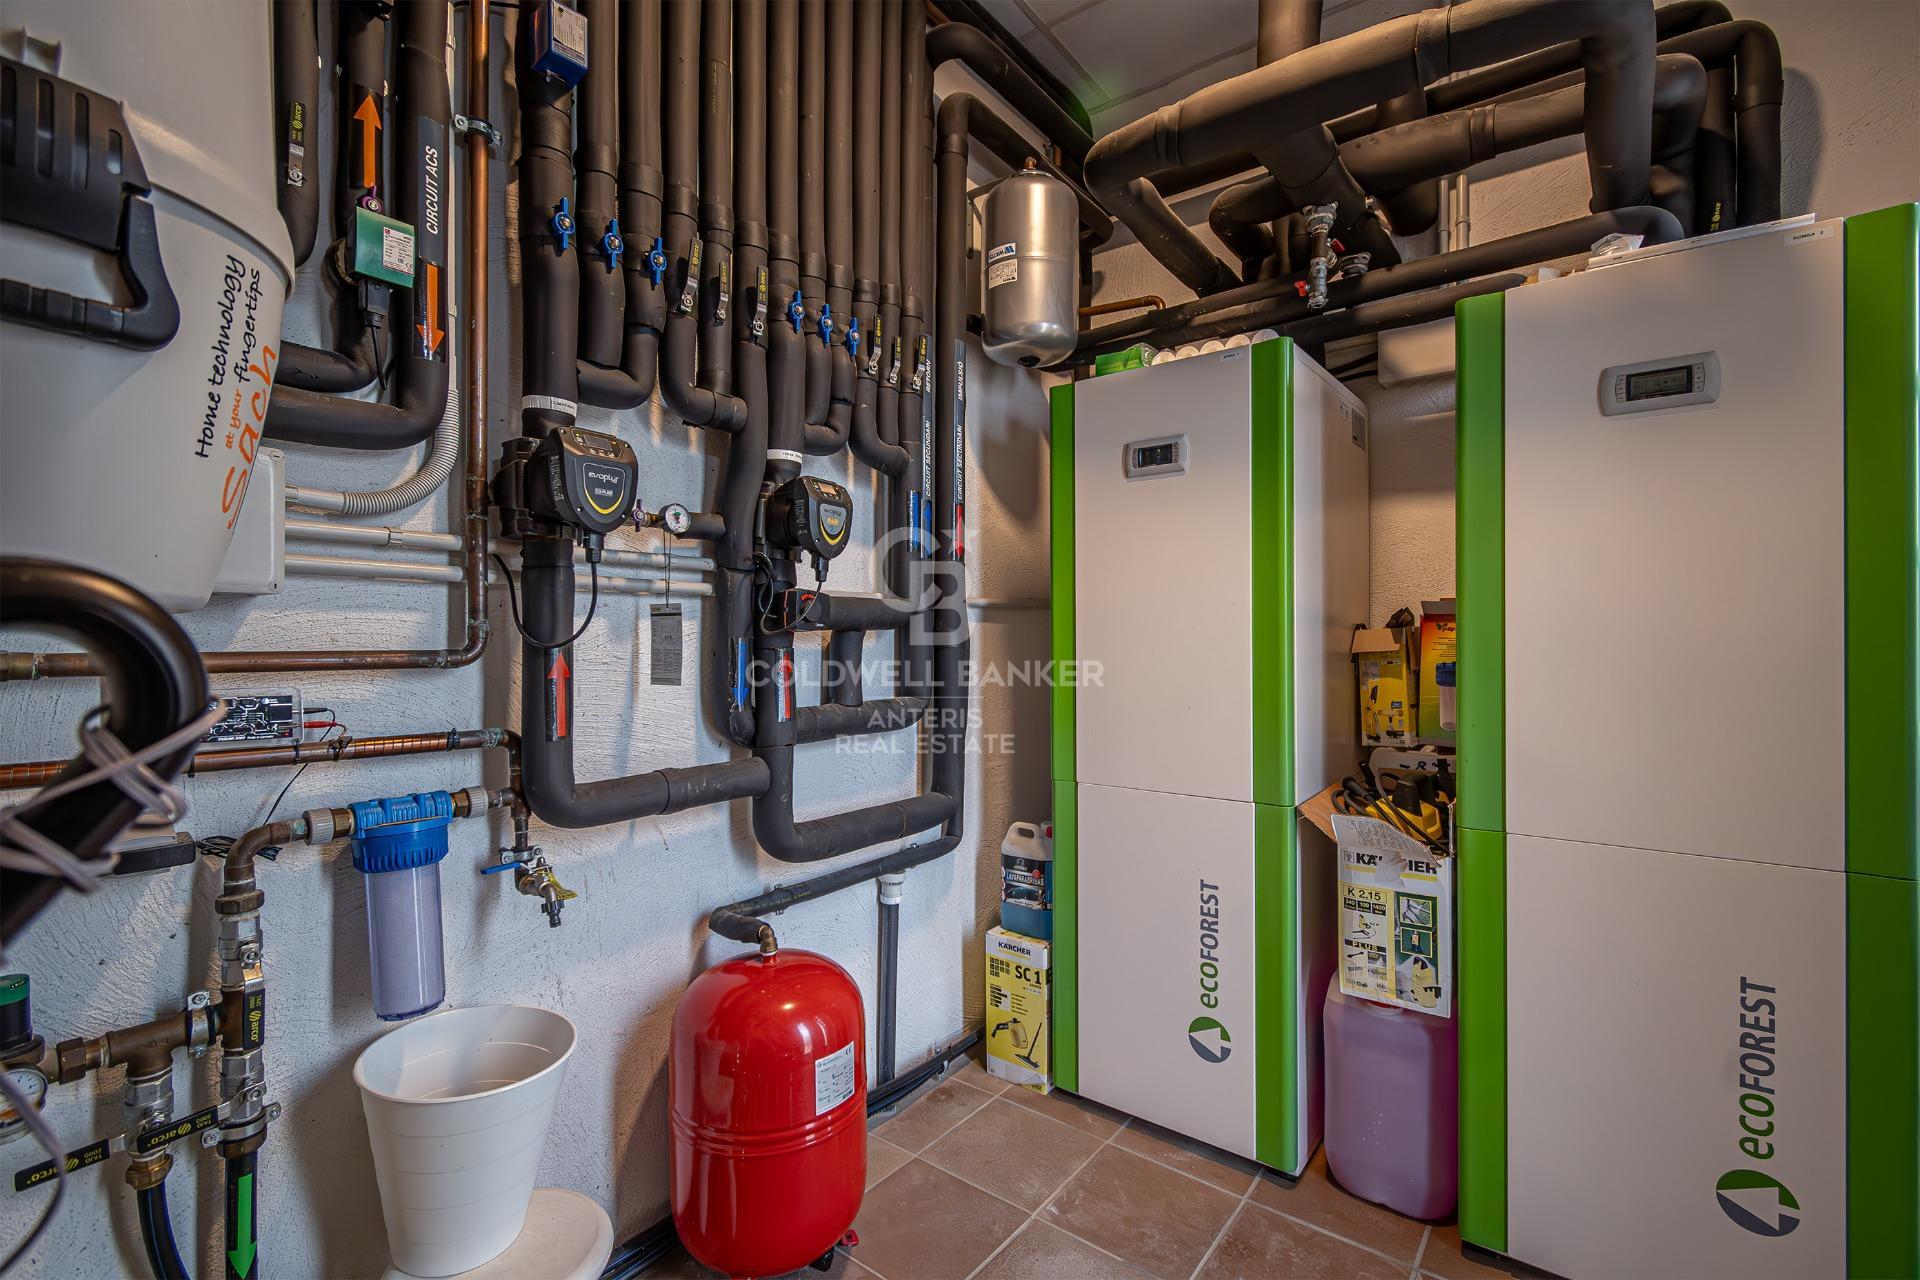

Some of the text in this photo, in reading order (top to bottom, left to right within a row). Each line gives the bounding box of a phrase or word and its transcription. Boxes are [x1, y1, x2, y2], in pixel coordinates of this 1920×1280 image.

[425, 145, 438, 235] CIRCUIT ACS
[195, 254, 246, 458] Home technology
[225, 268, 263, 449] at your fingertips
[221, 344, 277, 529] Sach
[1347, 887, 1381, 901] K 2.15
[1352, 941, 1378, 952] PLUS
[1015, 965, 1031, 983] SC
[1034, 970, 1042, 985] 1
[250, 1020, 259, 1041] arco
[151, 1128, 177, 1146] arco
